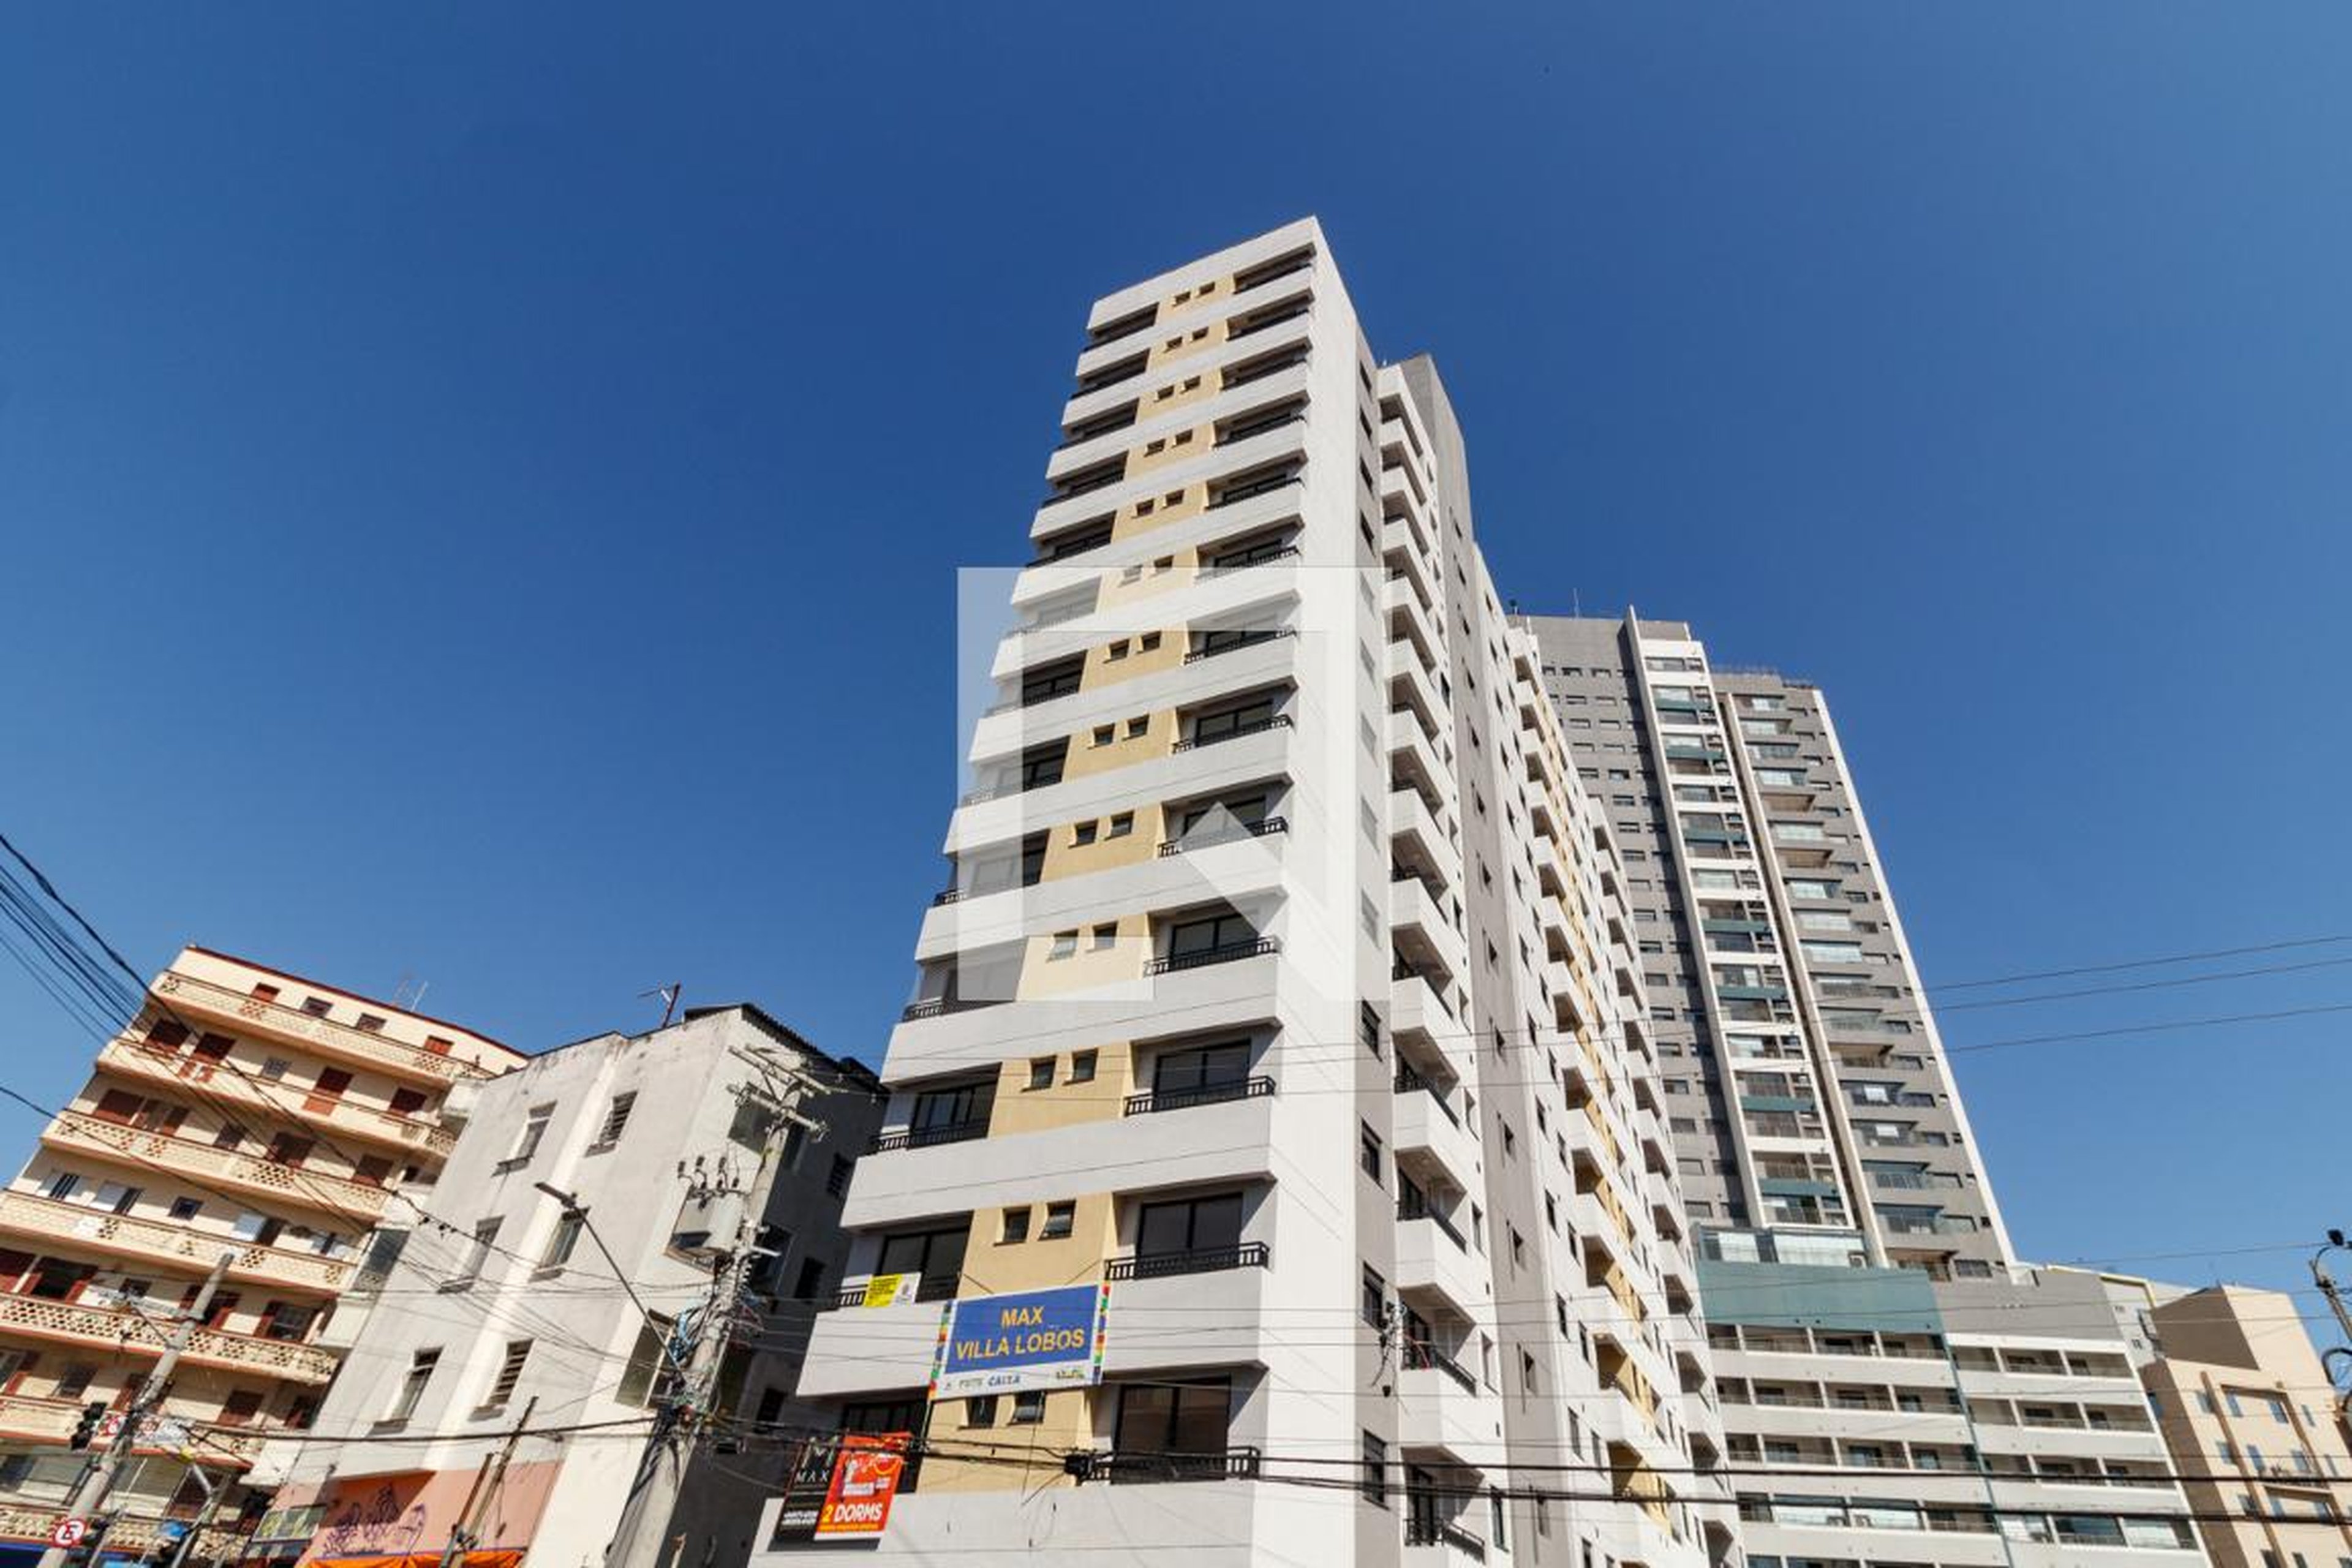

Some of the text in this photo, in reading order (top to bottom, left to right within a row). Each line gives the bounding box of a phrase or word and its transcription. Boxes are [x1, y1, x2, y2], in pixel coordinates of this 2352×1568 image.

[1001, 1305, 1044, 1328] MAX
[956, 1328, 1085, 1360] VILLA LOBOS
[795, 1470, 829, 1483] MAX
[821, 1504, 834, 1523] 2
[834, 1502, 883, 1523] DORMS
